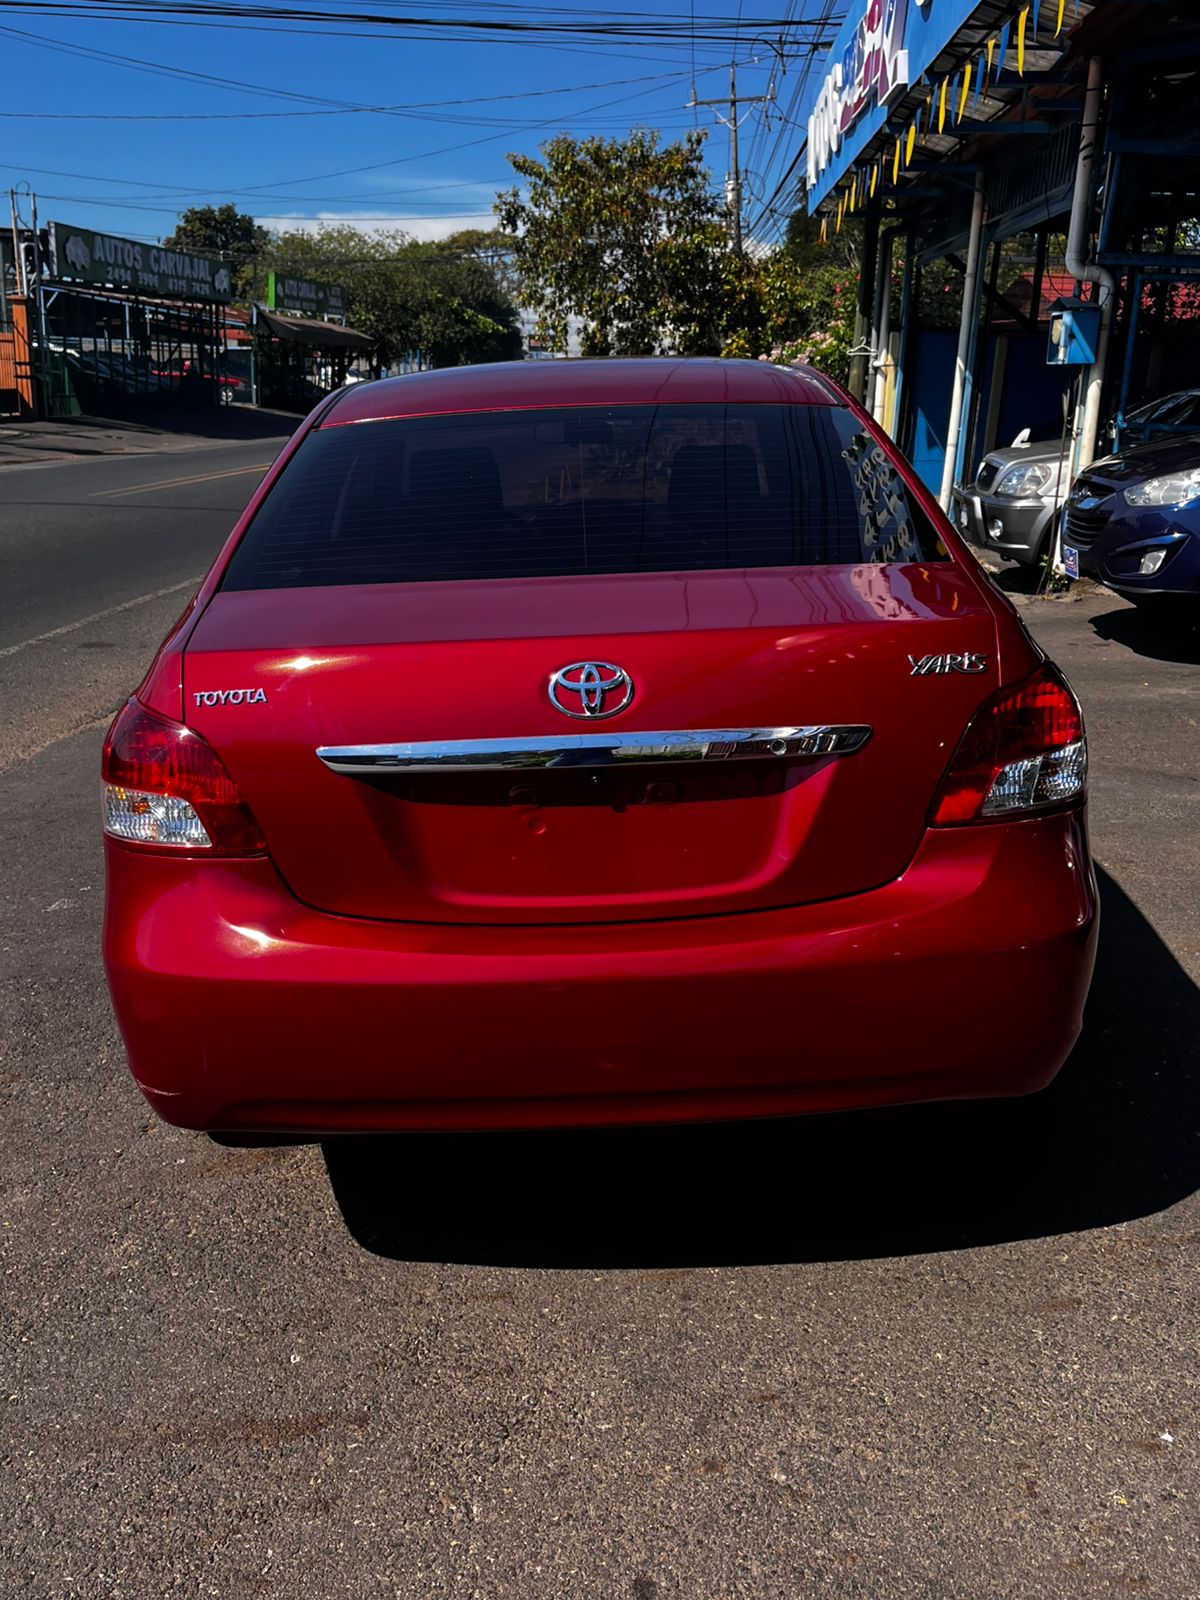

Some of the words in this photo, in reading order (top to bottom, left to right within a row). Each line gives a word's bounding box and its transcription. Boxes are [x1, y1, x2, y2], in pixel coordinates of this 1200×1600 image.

[94, 236, 143, 270] AUTOS
[150, 249, 212, 282] CARVAJAL
[193, 687, 267, 707] TOYOTA
